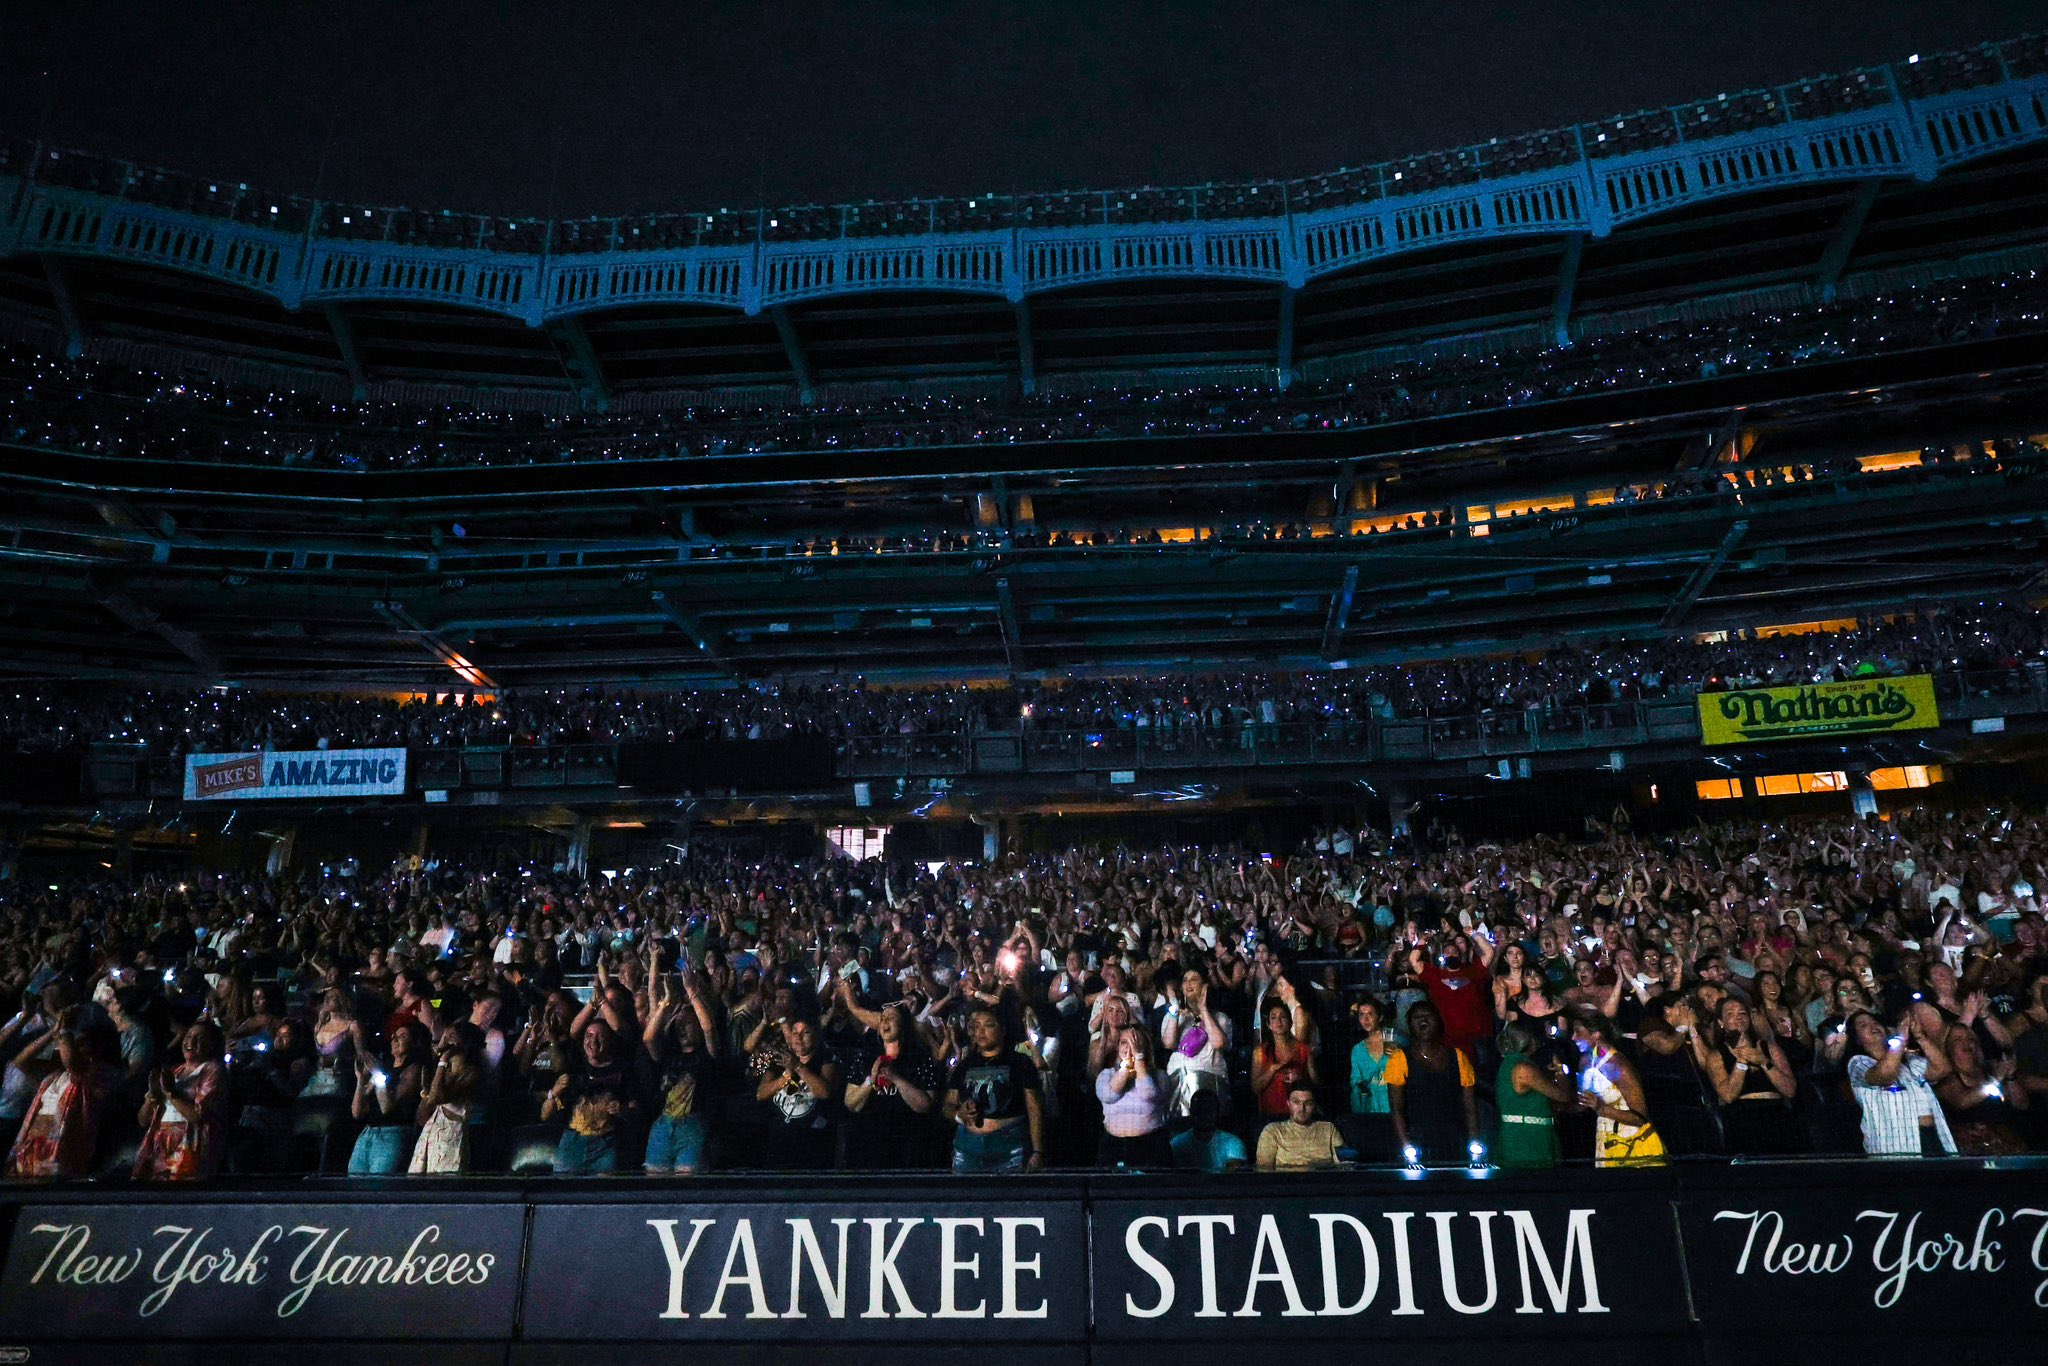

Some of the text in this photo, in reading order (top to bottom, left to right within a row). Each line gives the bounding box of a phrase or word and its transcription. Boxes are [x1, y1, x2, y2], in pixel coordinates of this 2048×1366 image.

[1719, 682, 1907, 726] Nathan's
[1826, 686, 1847, 694] Since
[205, 759, 397, 788] MIKE'S AMAZING
[30, 1222, 496, 1318] New York Yankees
[646, 1209, 1611, 1319] YANKEE STADIUM
[1713, 1209, 1854, 1275] New
[1856, 1207, 2006, 1309] York
